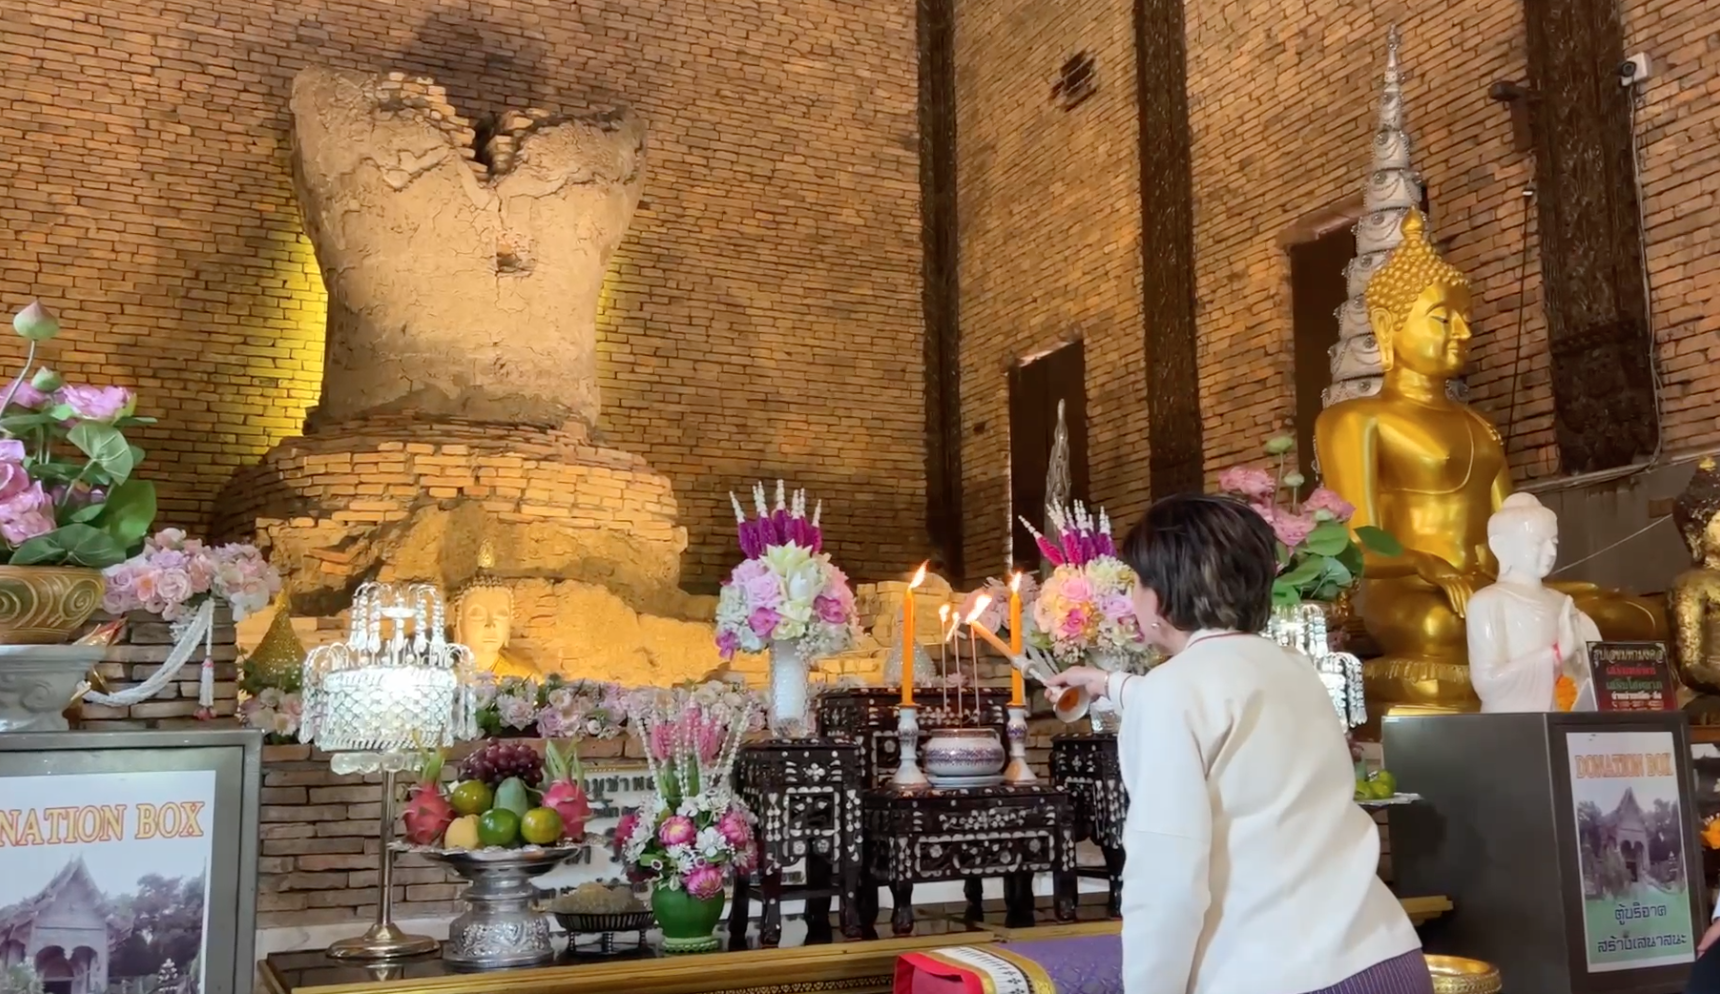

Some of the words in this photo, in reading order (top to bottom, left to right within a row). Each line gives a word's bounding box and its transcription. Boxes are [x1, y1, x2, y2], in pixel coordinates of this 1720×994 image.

[1574, 754, 1644, 779] DONATION
[1646, 753, 1673, 776] BOX
[0, 803, 127, 847] NATION
[135, 801, 206, 840] BOX
[1614, 902, 1667, 925] ตู้บริจาค
